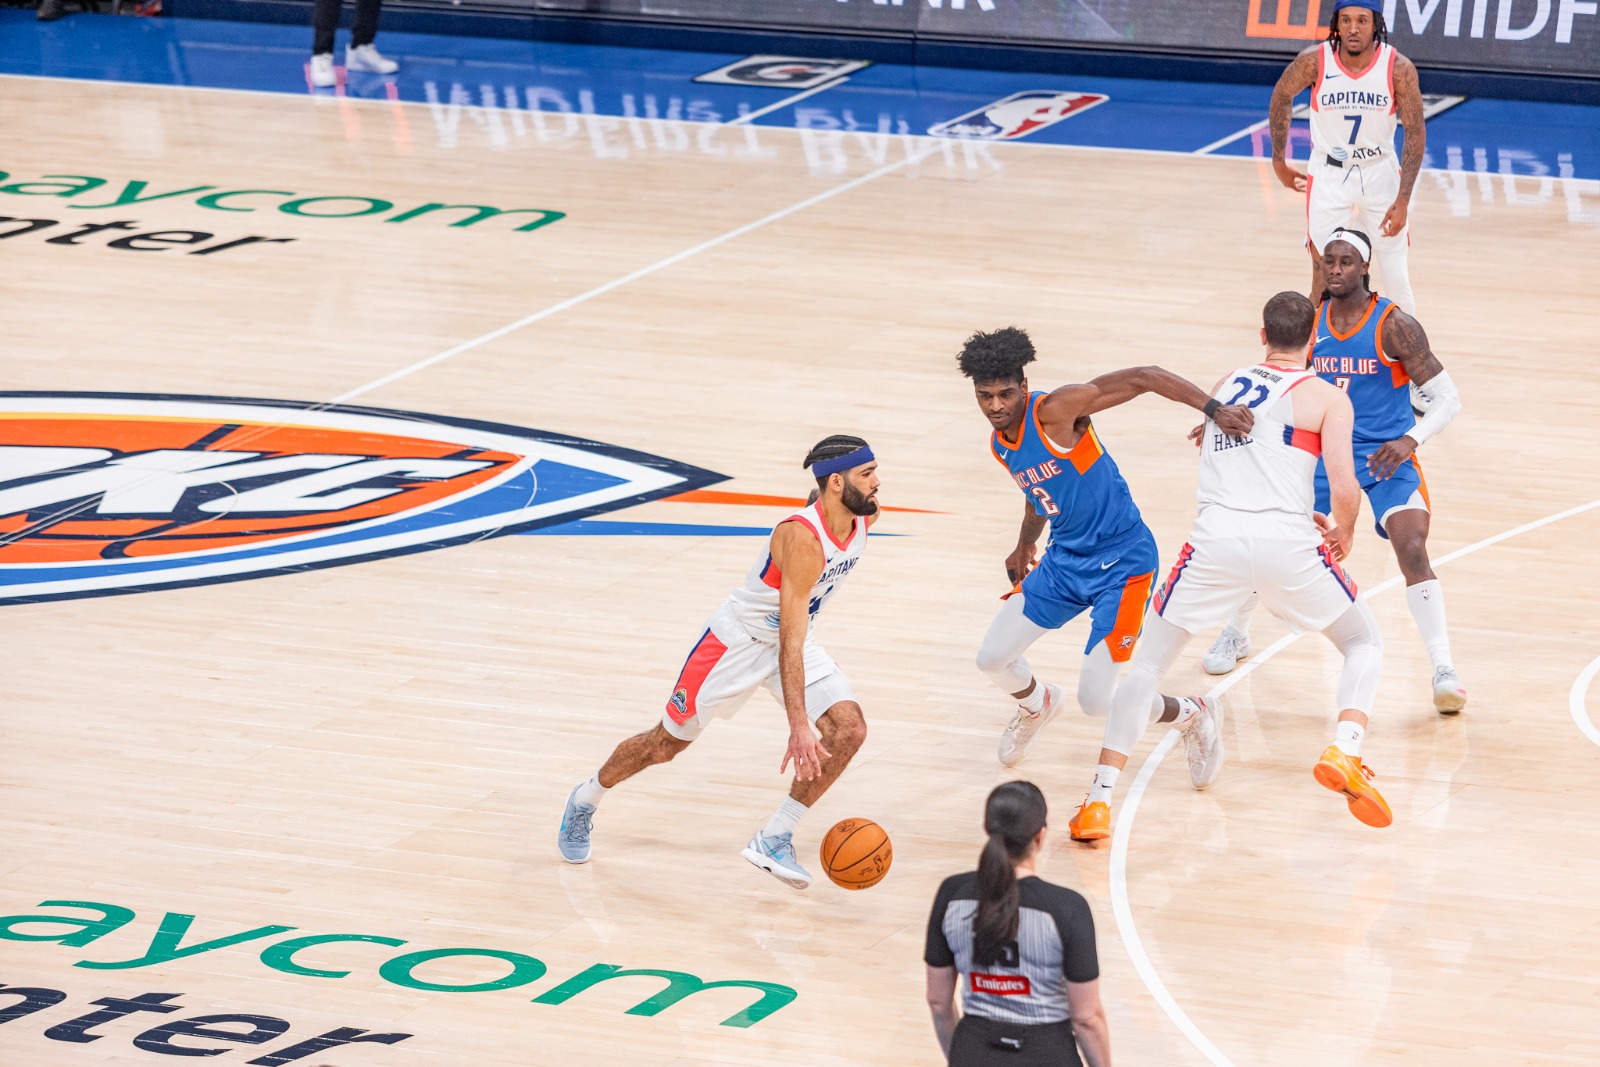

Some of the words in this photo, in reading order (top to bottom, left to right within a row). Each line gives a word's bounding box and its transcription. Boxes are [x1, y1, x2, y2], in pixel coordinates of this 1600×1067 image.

[1321, 91, 1389, 107] CAPITANES
[1343, 114, 1362, 145] 7
[1352, 146, 1382, 160] AT&T
[0, 171, 567, 232] aycom
[1313, 356, 1339, 373] OKC
[1340, 356, 1379, 375] BLUE
[1026, 459, 1063, 484] BLUE
[1030, 486, 1060, 516] 2
[974, 976, 1026, 991] Emirates
